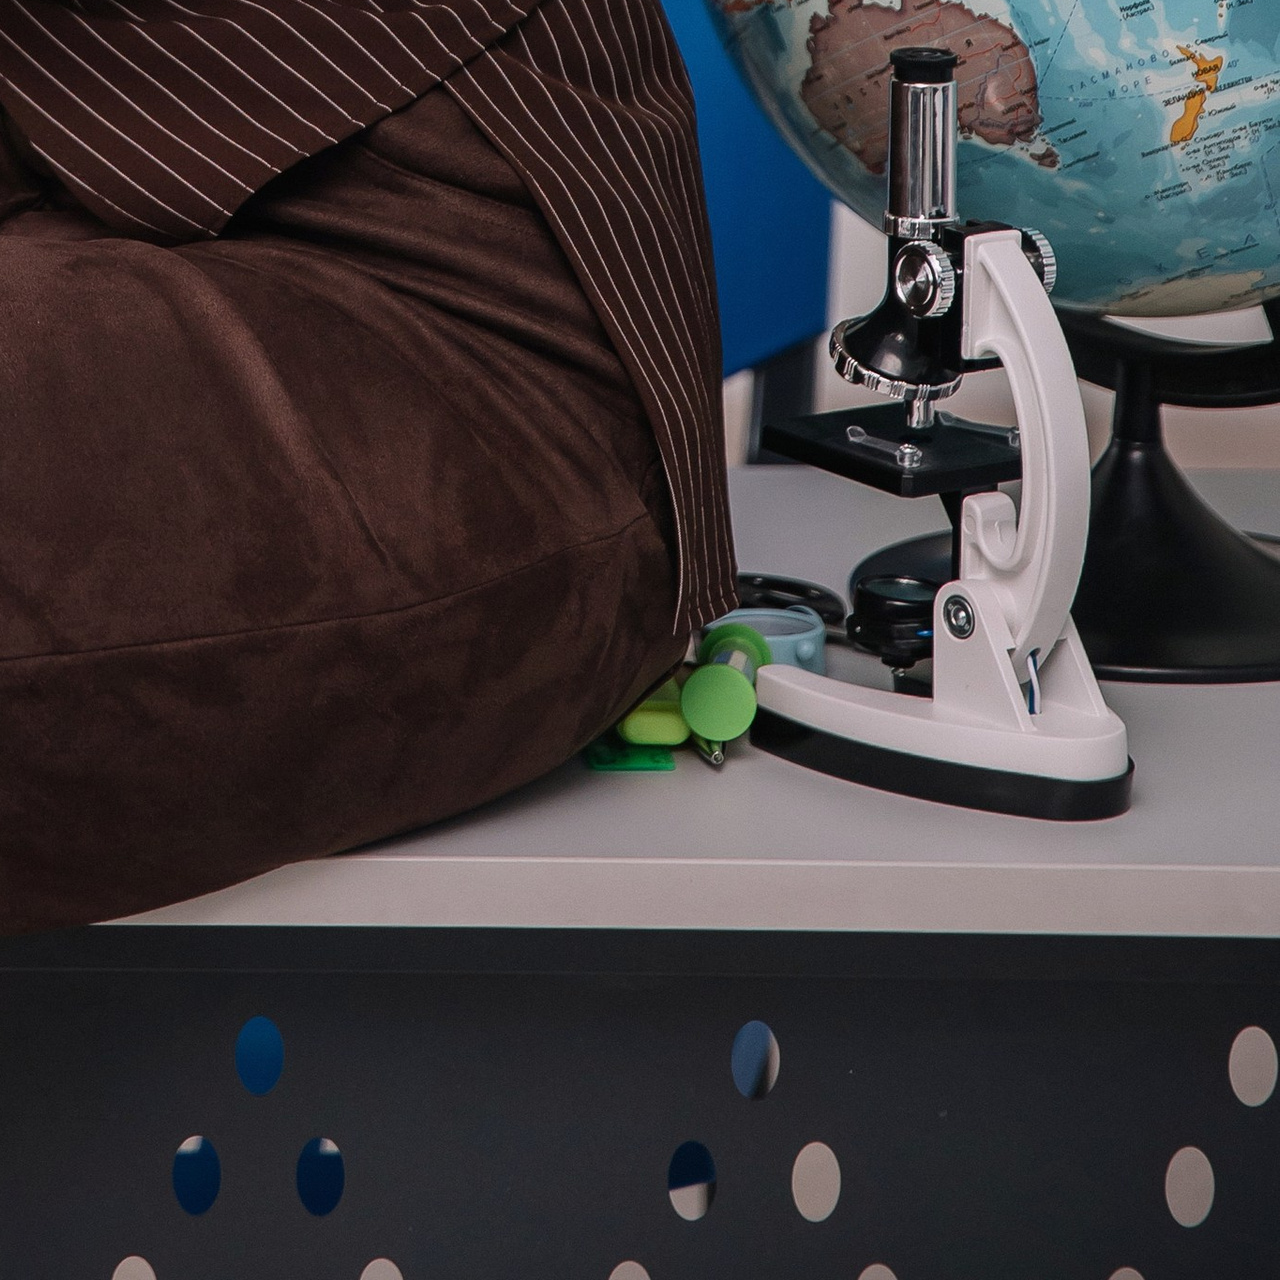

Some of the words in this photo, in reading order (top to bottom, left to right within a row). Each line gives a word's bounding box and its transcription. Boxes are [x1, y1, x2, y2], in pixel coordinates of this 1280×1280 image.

[1069, 49, 1170, 93] ТАСМАНОВО
[1191, 64, 1220, 78] НОВАЯ
[1108, 75, 1152, 98] МОРЕ
[1208, 102, 1237, 117] Южный
